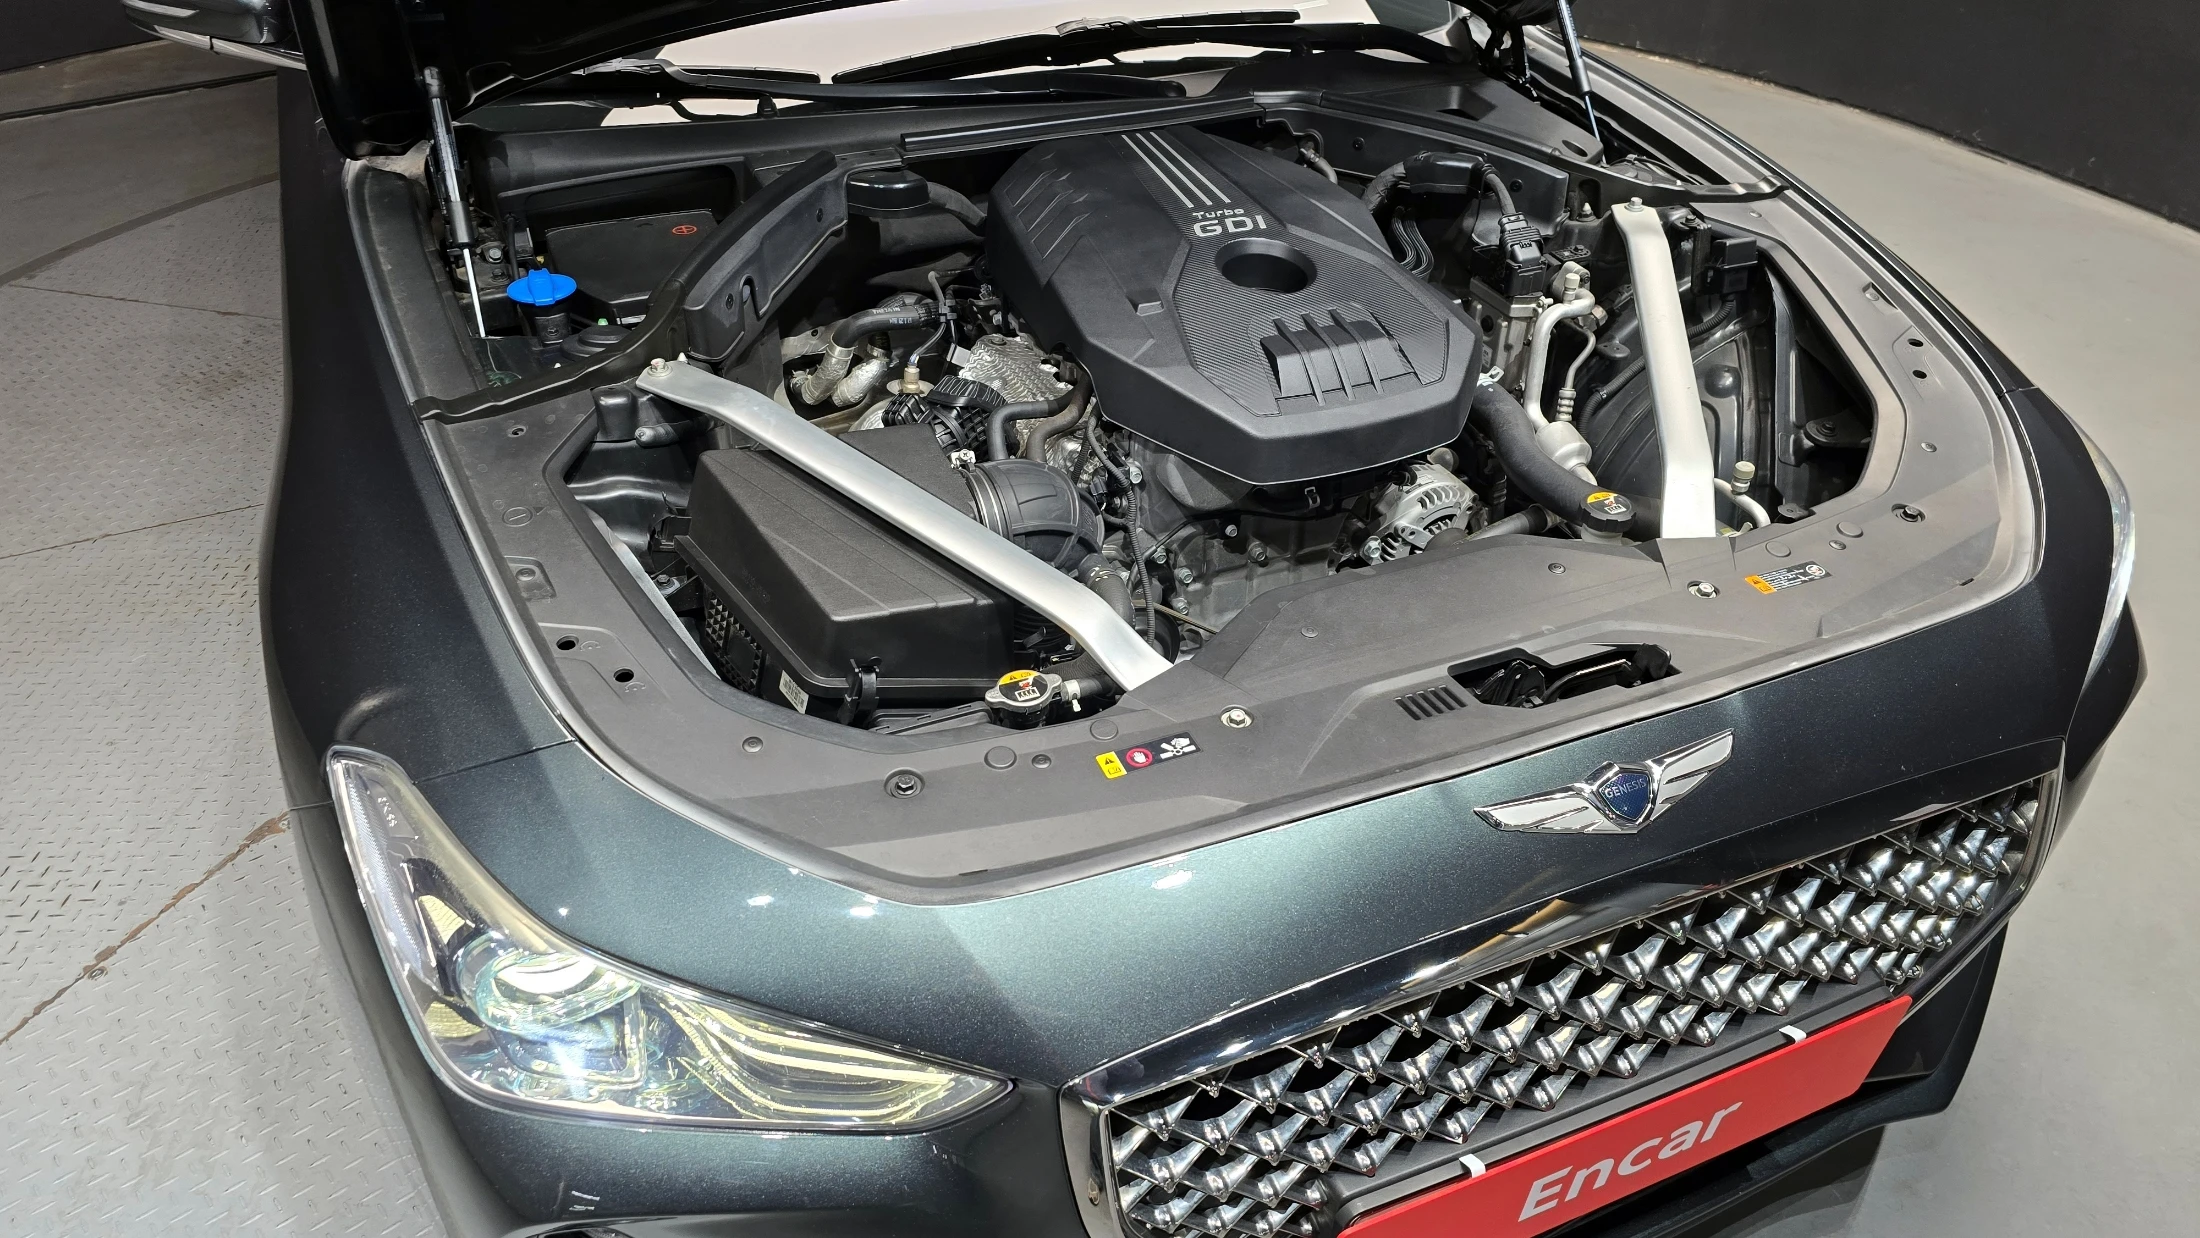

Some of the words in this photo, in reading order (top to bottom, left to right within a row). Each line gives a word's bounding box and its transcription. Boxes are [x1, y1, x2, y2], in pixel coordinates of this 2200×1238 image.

[1193, 208, 1244, 220] Turbo
[1193, 215, 1267, 237] GDI
[1605, 778, 1646, 798] GENESIS
[1517, 1101, 1743, 1222] Encar
